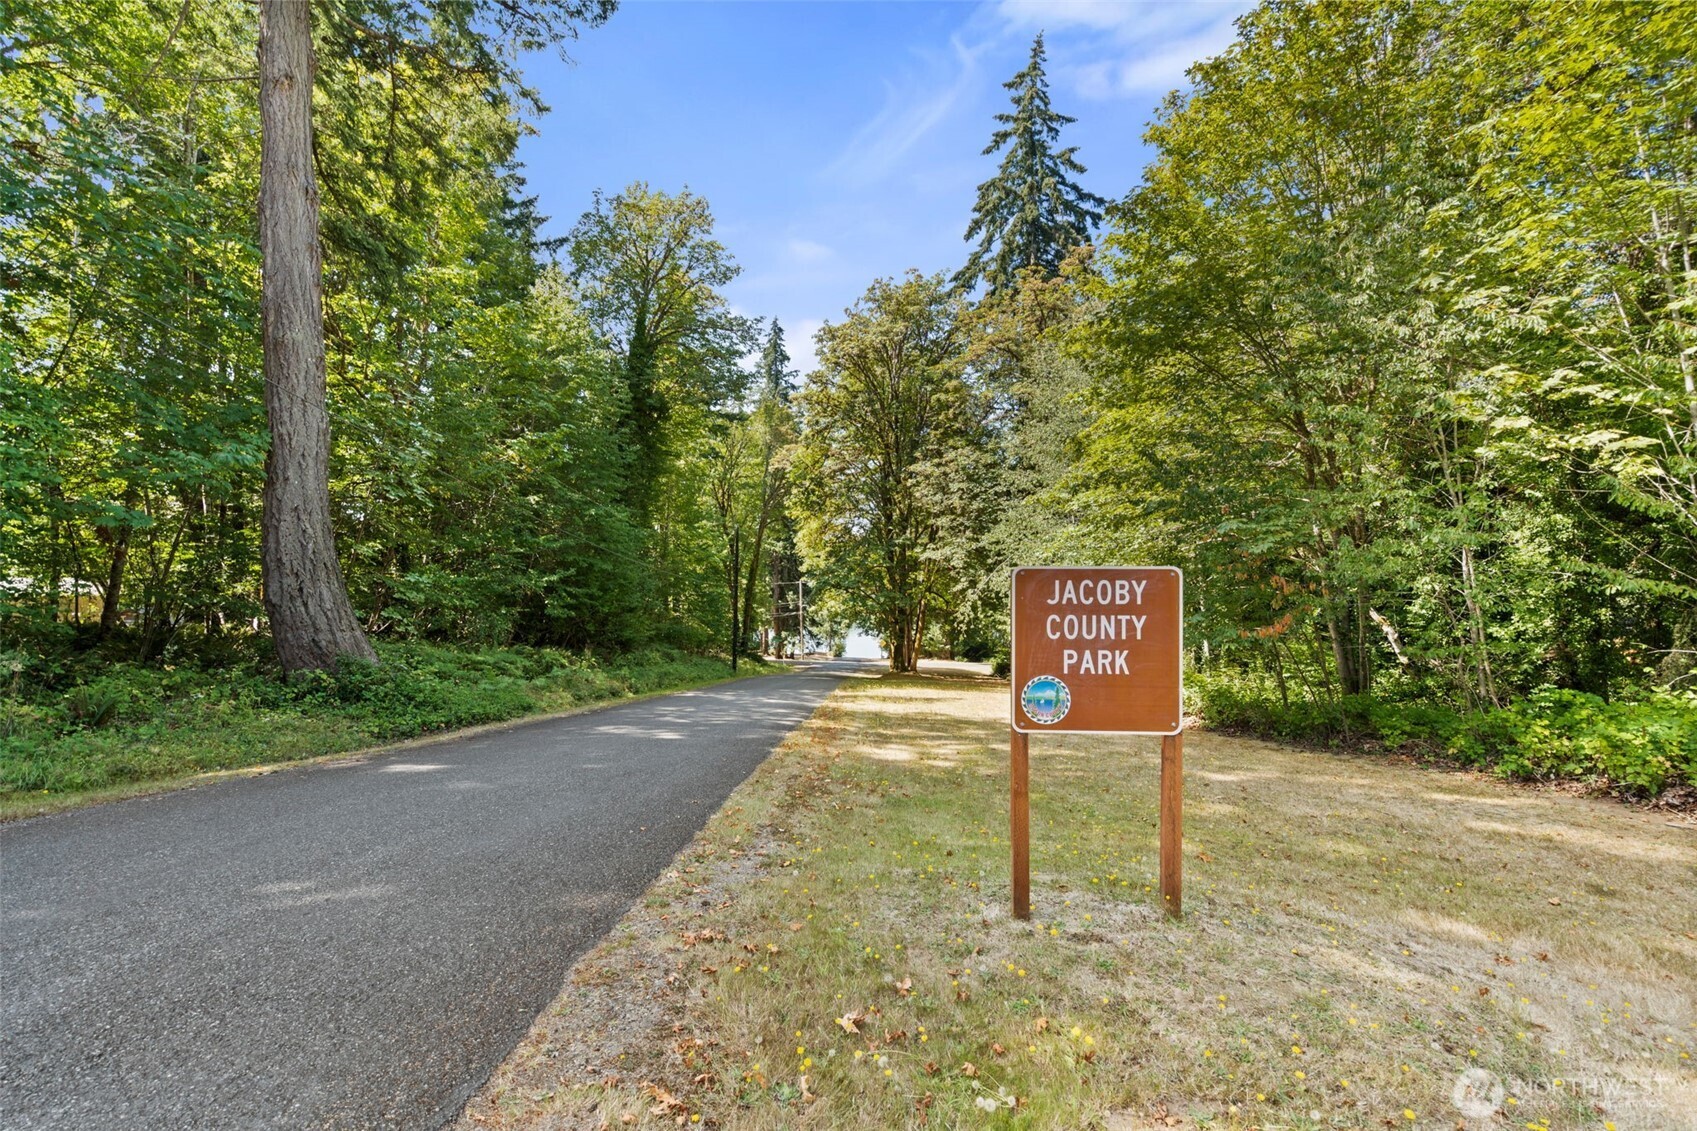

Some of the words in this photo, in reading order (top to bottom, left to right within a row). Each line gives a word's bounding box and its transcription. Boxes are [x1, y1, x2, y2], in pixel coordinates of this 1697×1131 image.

[1047, 580, 1147, 605] JACOBY
[1046, 614, 1147, 640] COUNTY
[1063, 649, 1130, 675] PARK
